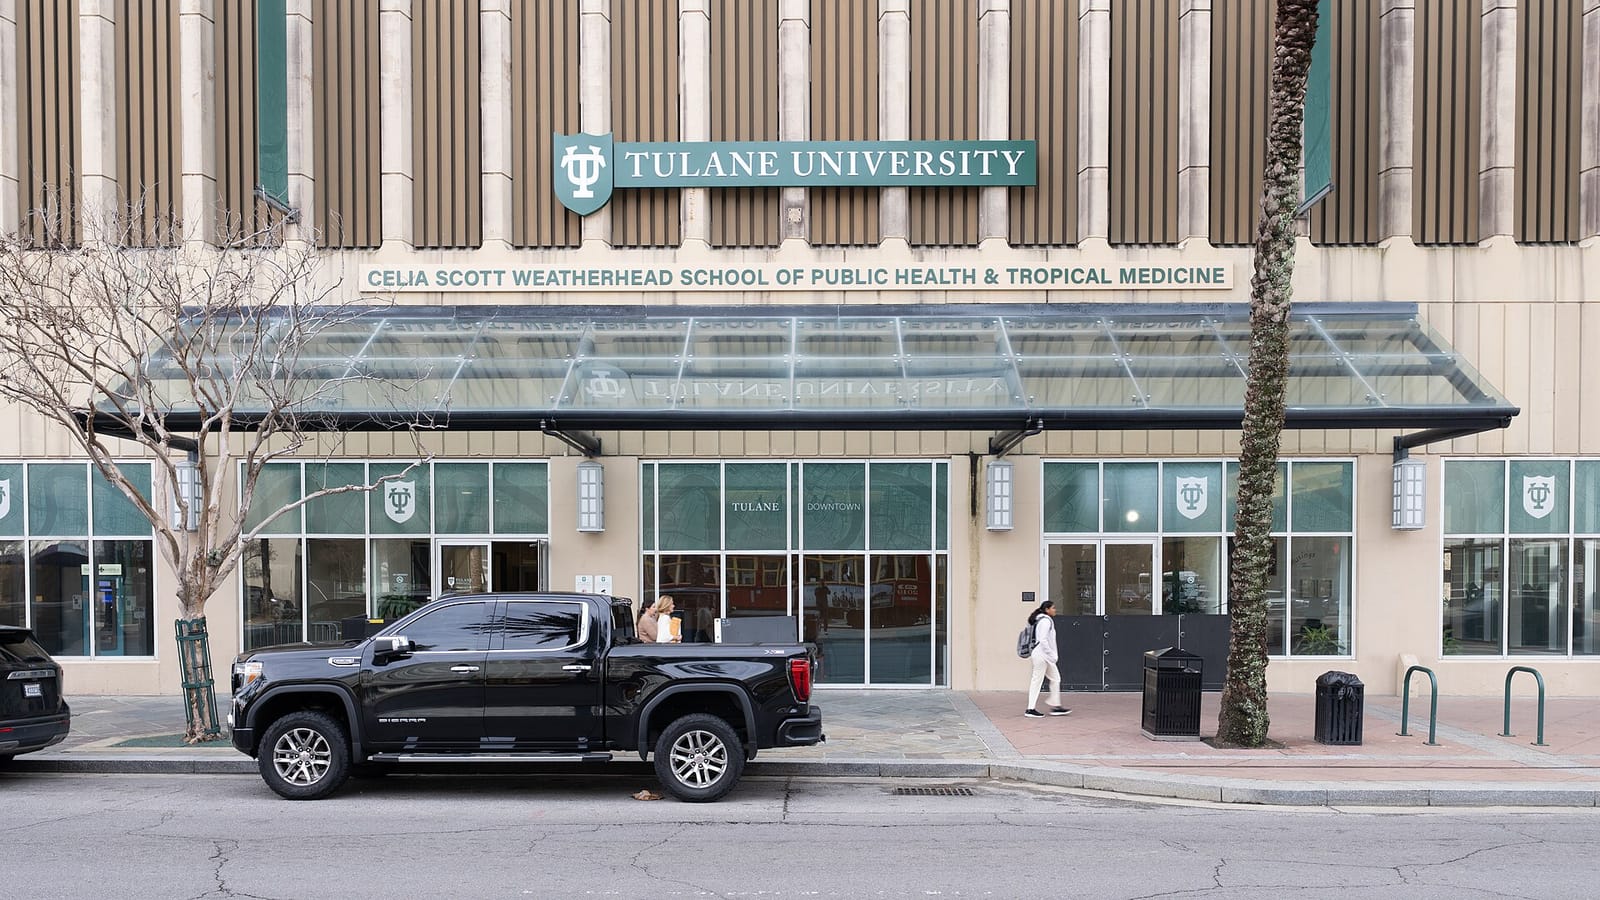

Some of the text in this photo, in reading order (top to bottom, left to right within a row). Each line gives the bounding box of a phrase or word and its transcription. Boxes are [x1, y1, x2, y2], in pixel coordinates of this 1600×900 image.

[625, 150, 1025, 178] TULANE UNIVERSITY
[368, 267, 1225, 287] CELIA SCOTT WEATHERHEAD SCHOOL OF PUBLIC HEALTH & TROPICAL MEDICINE
[732, 501, 861, 512] TULANE DOWNTOWN
